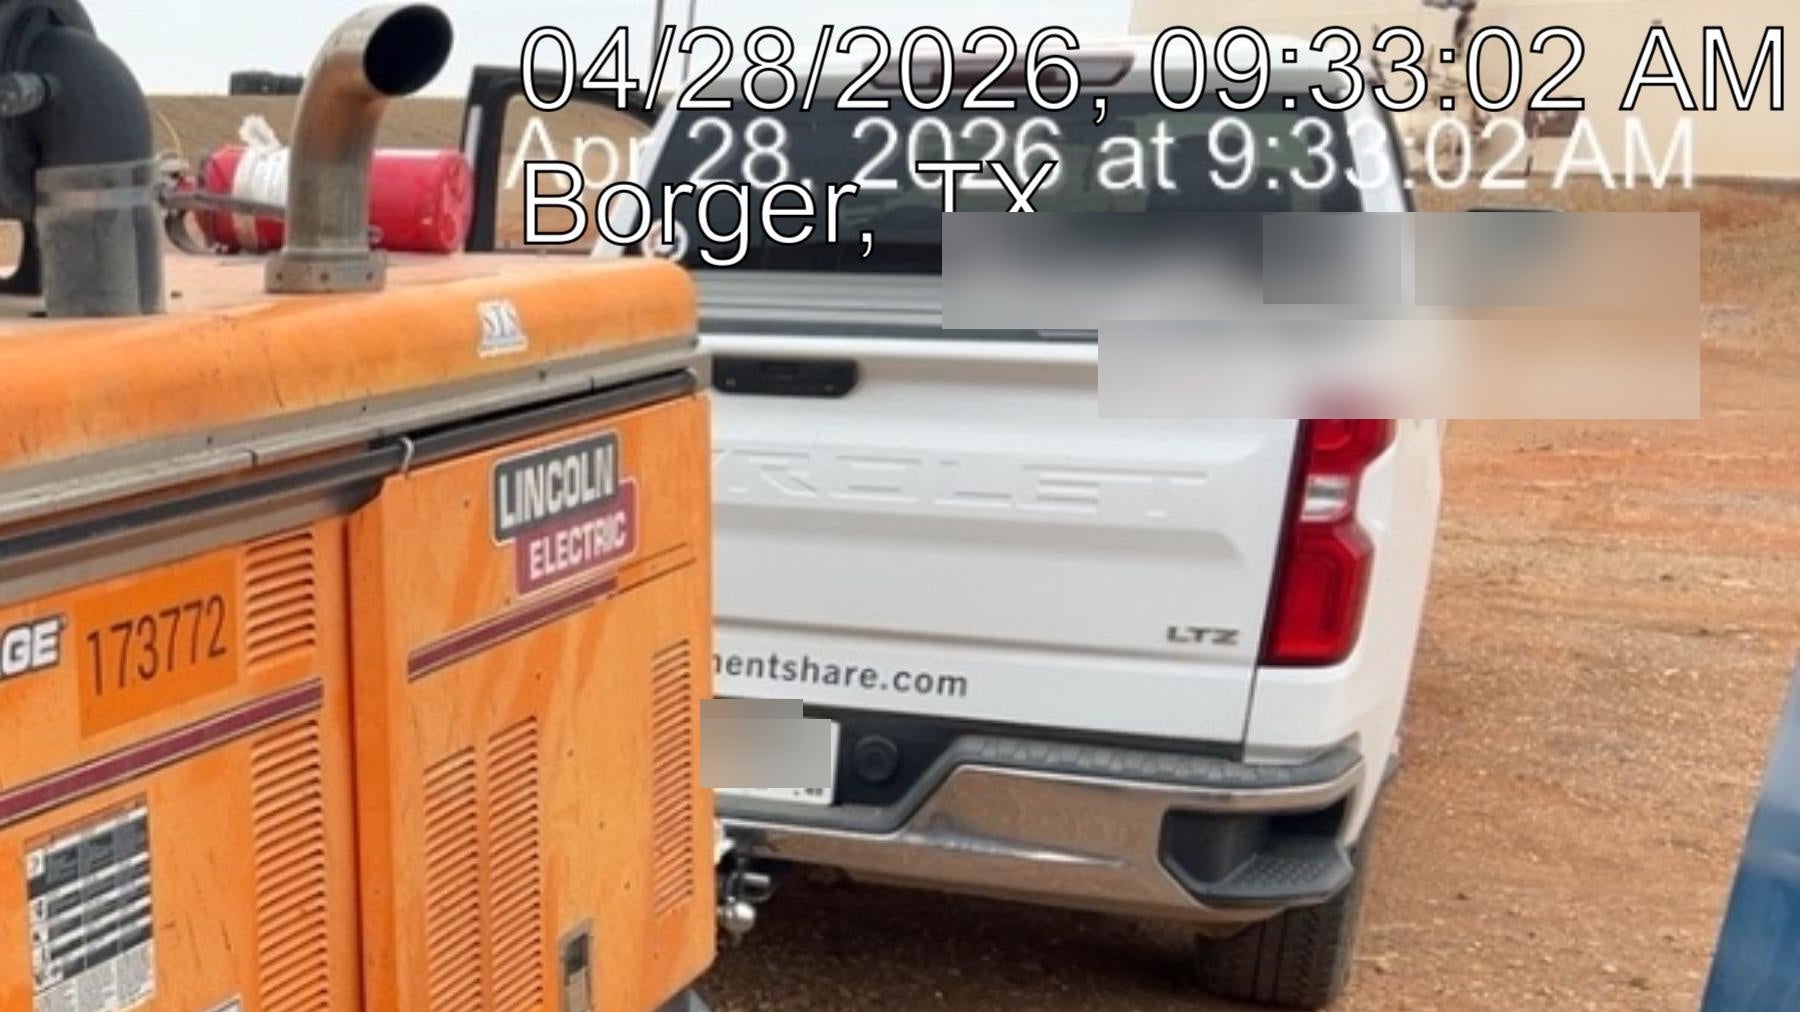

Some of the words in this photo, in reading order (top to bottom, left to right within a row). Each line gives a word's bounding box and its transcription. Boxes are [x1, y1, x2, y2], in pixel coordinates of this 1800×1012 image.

[499, 443, 614, 530] LINCOLN
[528, 510, 627, 581] ELECTRIC
[86, 594, 227, 697] 173772
[1166, 625, 1240, 646] LTZ
